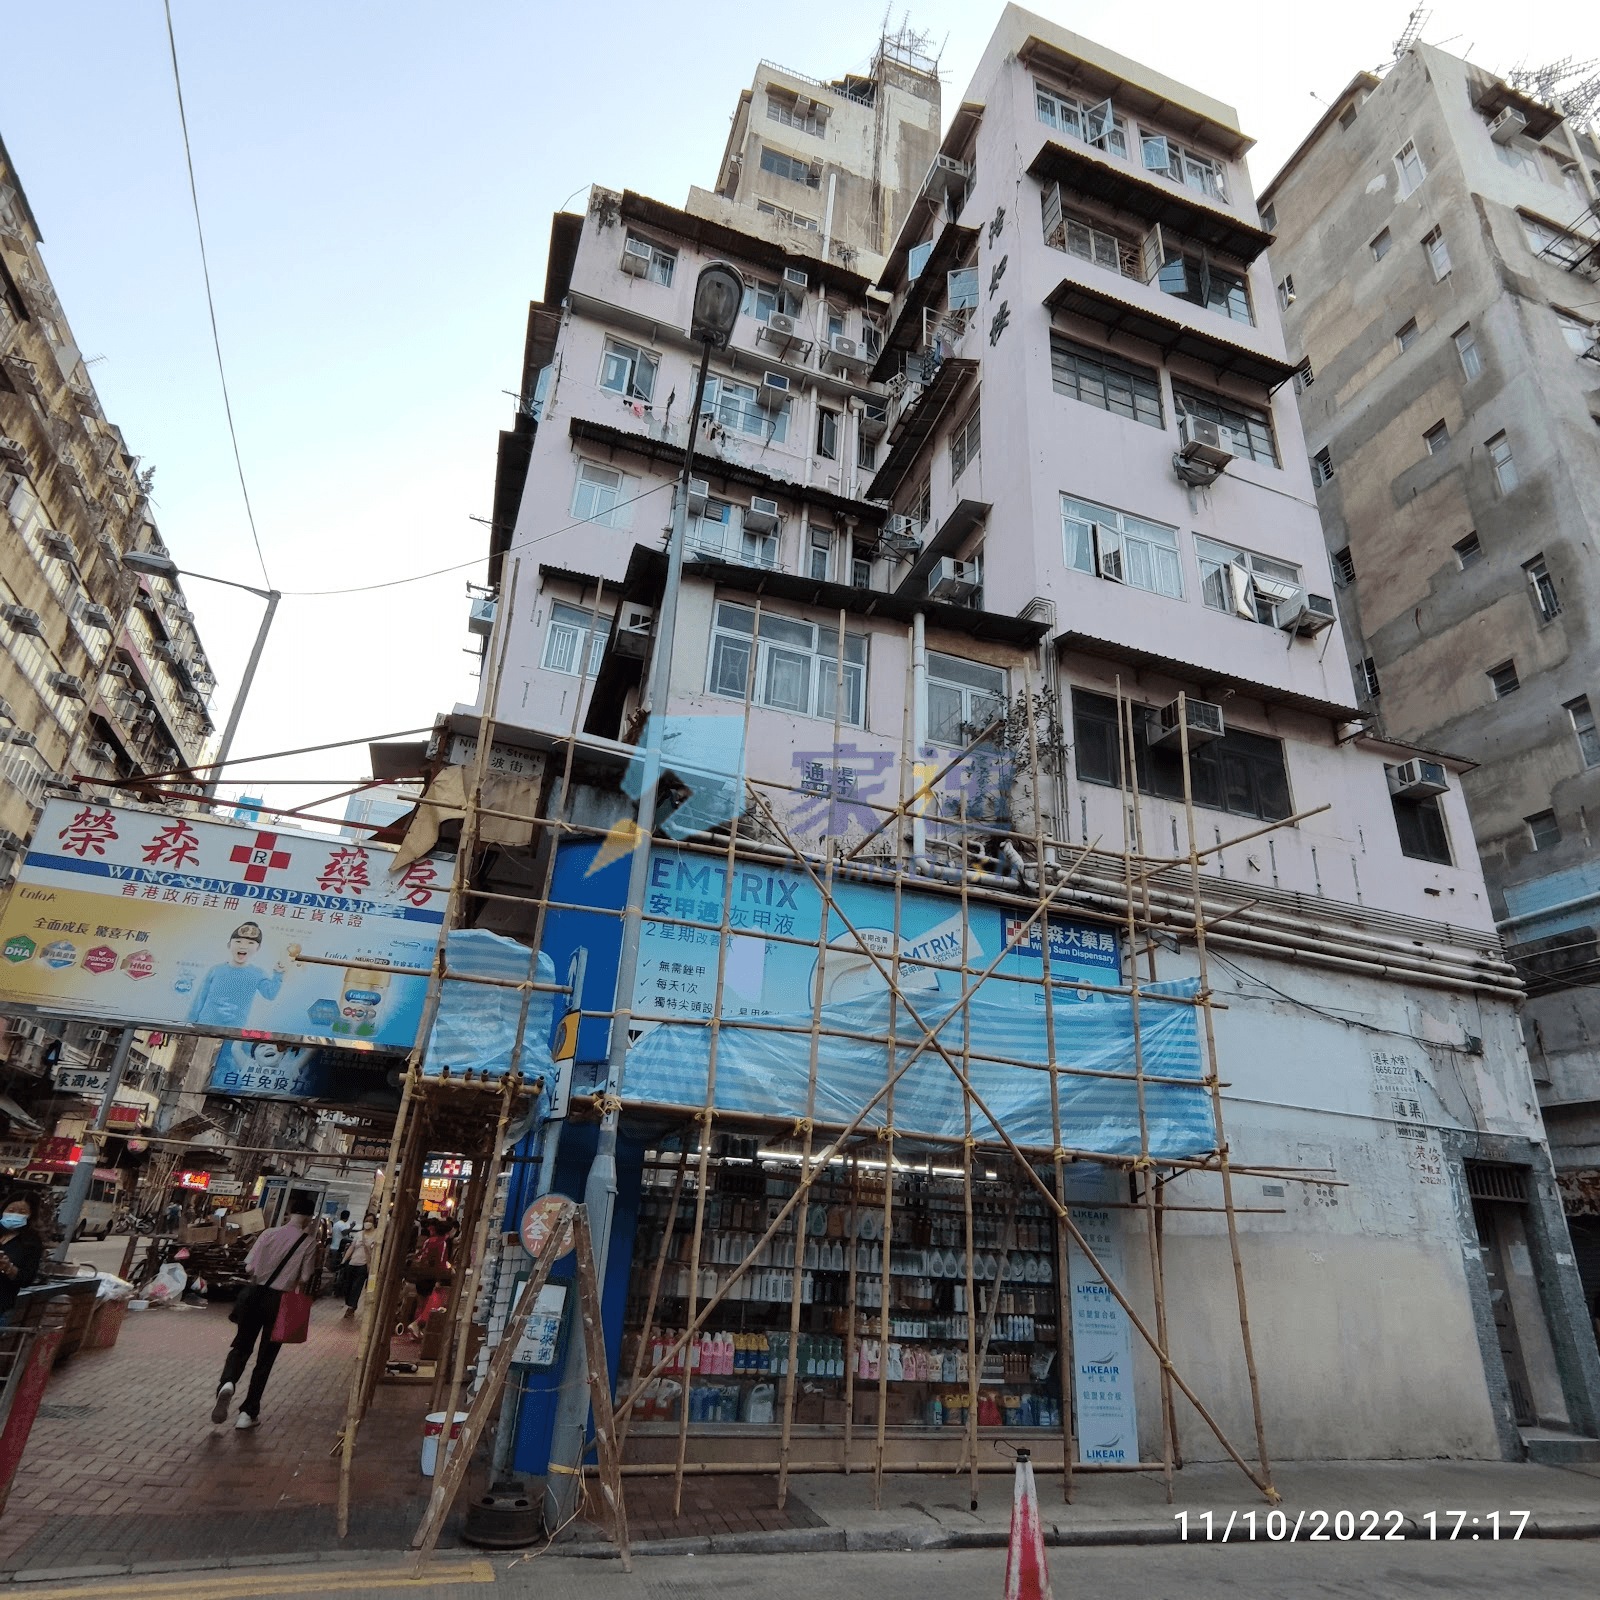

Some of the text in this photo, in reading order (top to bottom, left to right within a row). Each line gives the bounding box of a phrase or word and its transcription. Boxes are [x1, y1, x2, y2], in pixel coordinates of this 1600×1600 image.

[459, 738, 541, 763] Nino Street
[59, 806, 438, 907] 榮森 藥房
[107, 864, 175, 887] WING
[184, 876, 239, 896] SUM
[650, 857, 800, 911] EMTRIX
[121, 882, 364, 928] 香港政府註冊 優質正貨保證
[33, 917, 91, 935] 全面成長
[729, 905, 796, 936] 灰甲液
[5, 946, 31, 959] DHA
[1031, 941, 1115, 964] Wig Sam Dispensary
[656, 978, 698, 995] 每天1次
[1394, 1101, 1423, 1119] 通渠
[1072, 1210, 1109, 1220] LIKEAIR
[1081, 1365, 1120, 1375] LIKEAIR
[1086, 1449, 1125, 1459] LIKEAIR
